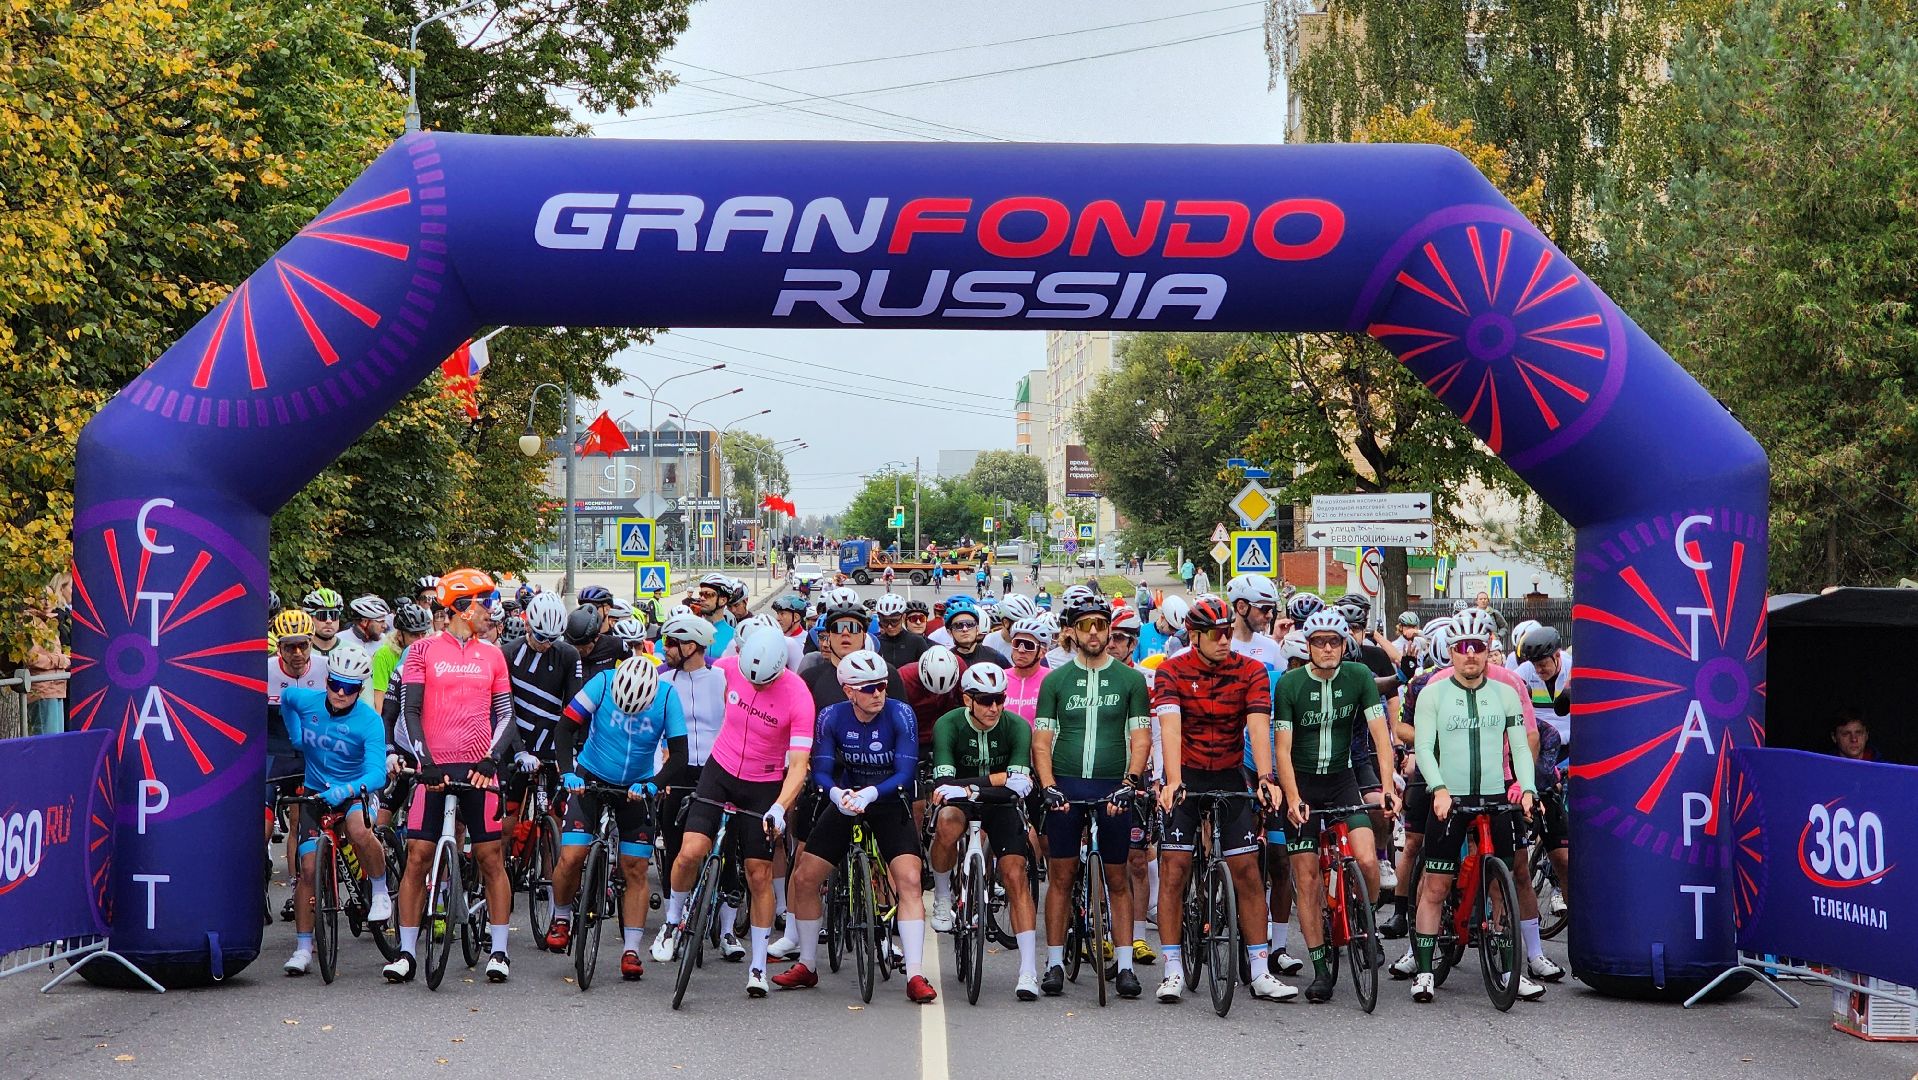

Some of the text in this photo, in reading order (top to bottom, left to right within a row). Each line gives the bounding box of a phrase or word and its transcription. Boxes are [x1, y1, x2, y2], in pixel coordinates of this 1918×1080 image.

[534, 193, 1345, 260] GRANFONDO
[772, 269, 1228, 324] RUSSIA
[1329, 525, 1356, 534] улица
[1331, 534, 1412, 543] РЕВОЛЮЦИОННАЯ
[434, 660, 482, 678] Ghisallo
[132, 497, 176, 930] СТАРТ
[1104, 693, 1120, 705] UP
[1339, 703, 1354, 719] UP
[610, 709, 654, 735] RCA
[1675, 514, 1716, 940] СТАРТ
[303, 727, 350, 756] RCA
[1808, 803, 1885, 885] 360
[1812, 895, 1888, 931] ТЕЛЕКАНАЛ
